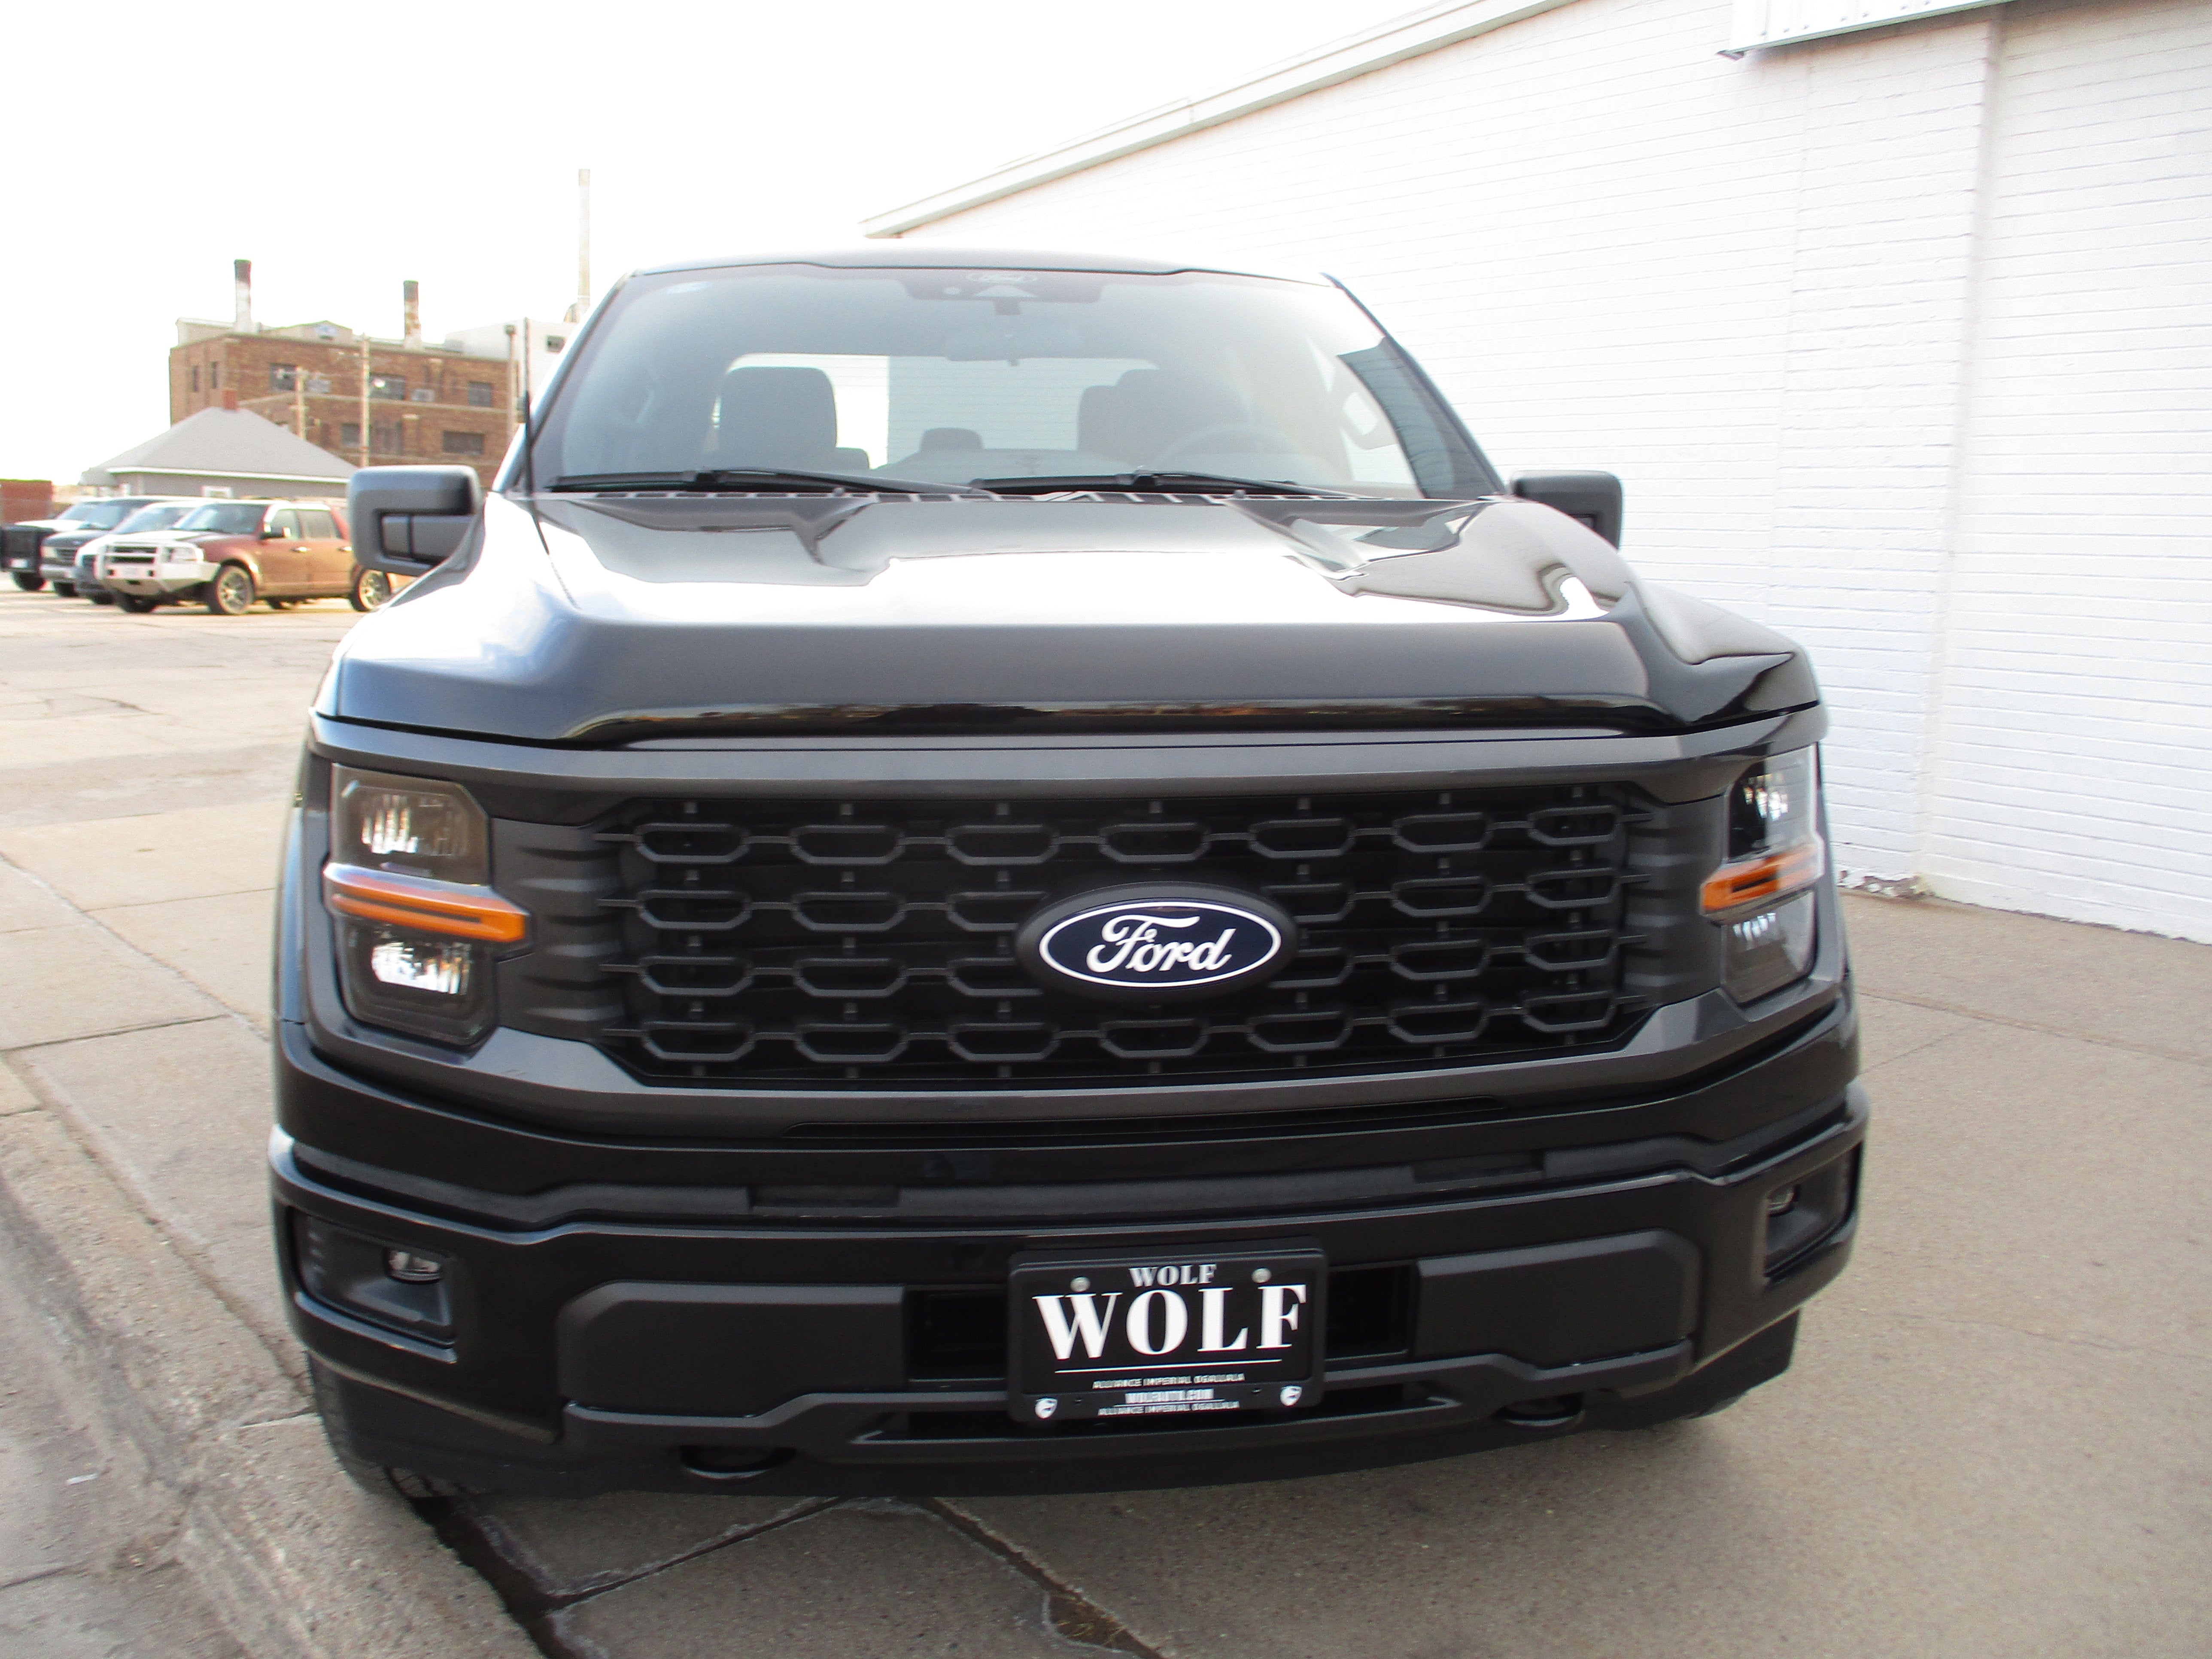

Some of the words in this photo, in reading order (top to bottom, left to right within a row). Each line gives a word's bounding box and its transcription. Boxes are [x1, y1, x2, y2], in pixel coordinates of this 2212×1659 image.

[1086, 915, 1236, 972] Ford
[1129, 1264, 1217, 1287] WOLF
[1032, 1284, 1307, 1360] WOLF
